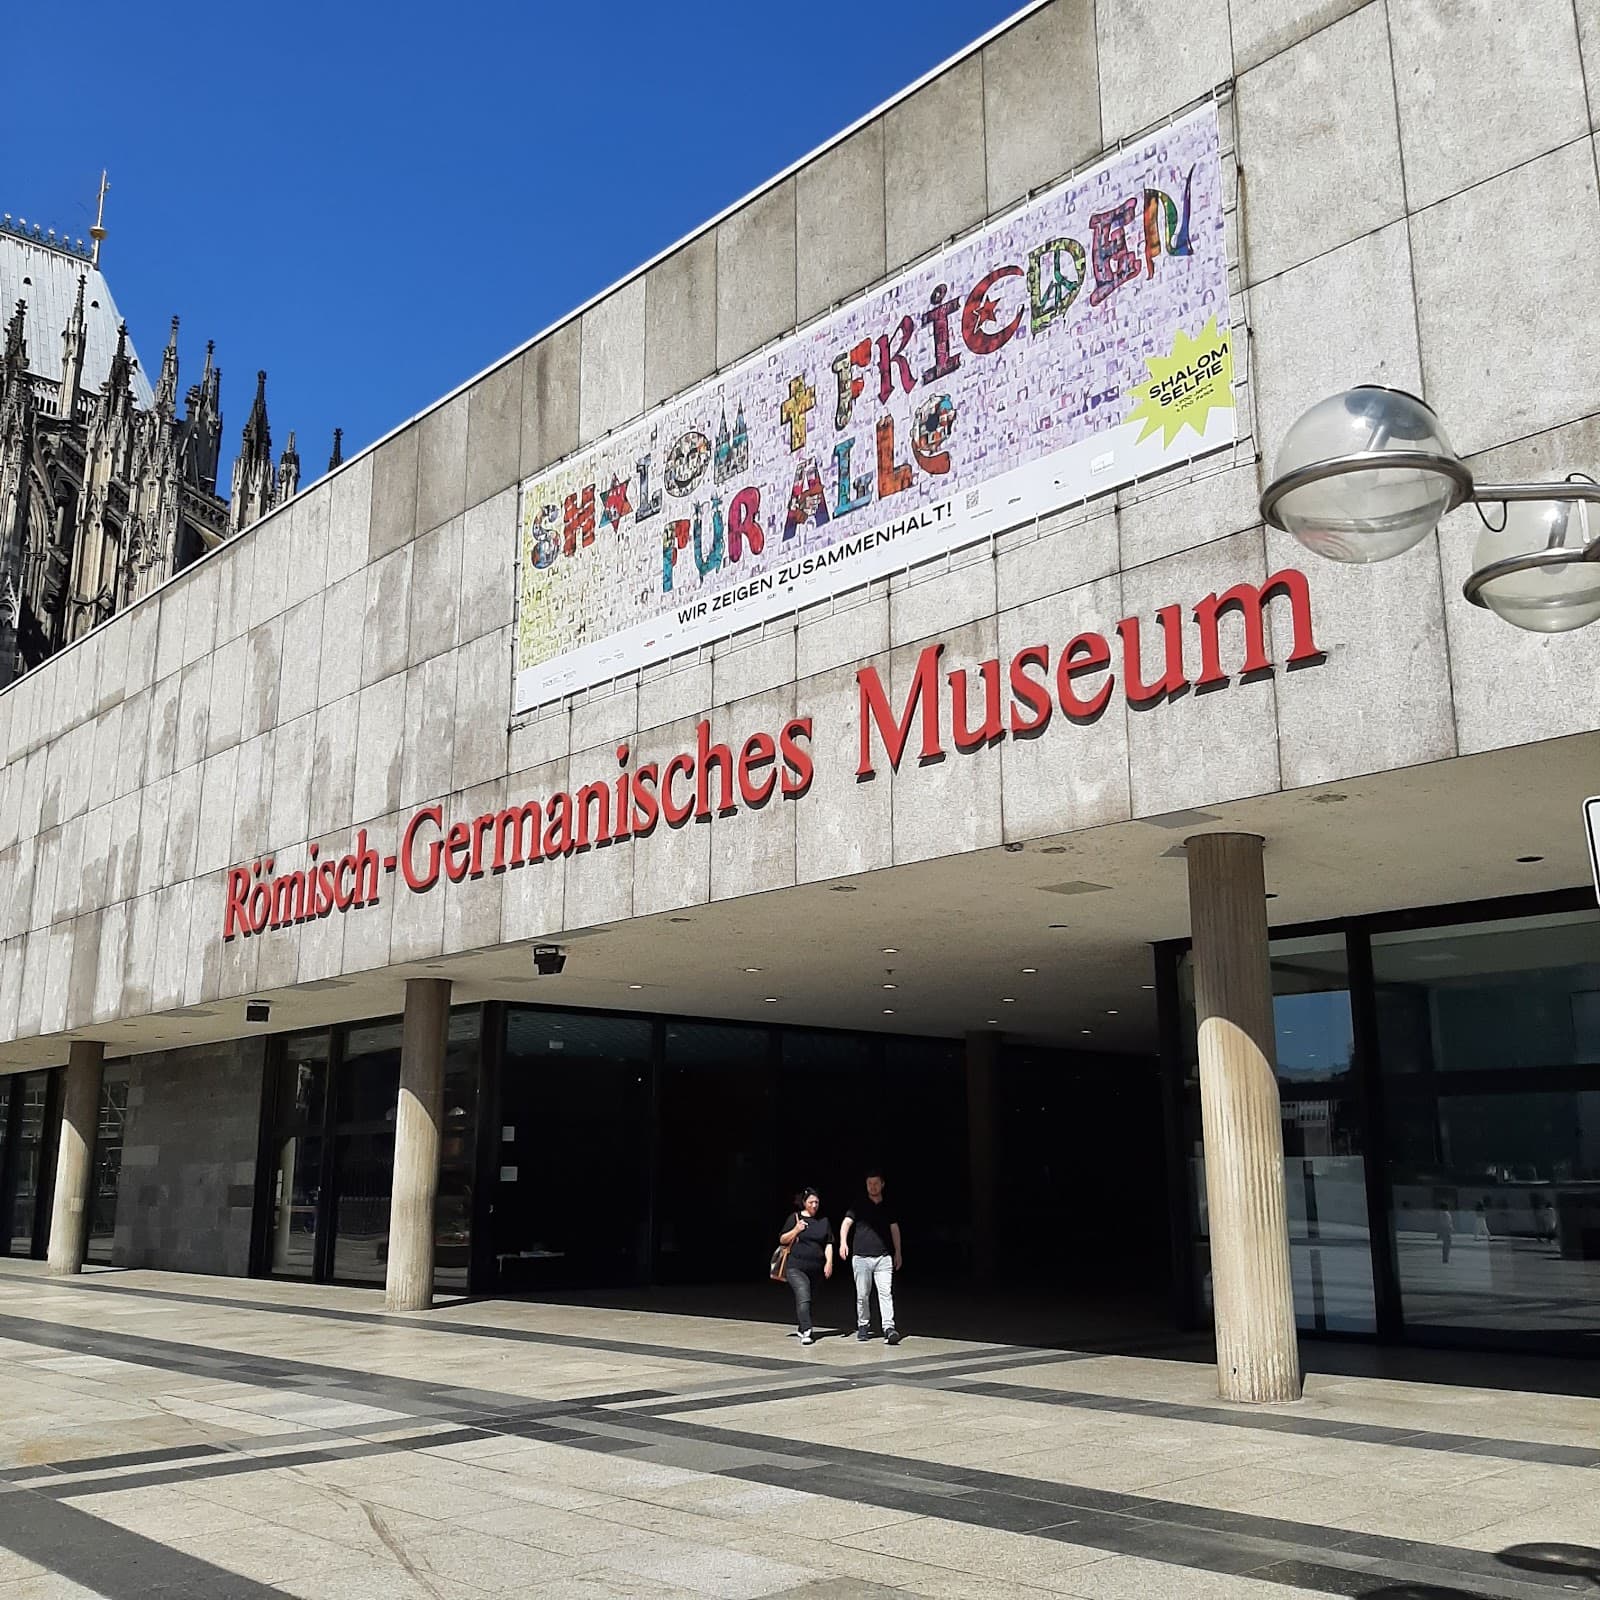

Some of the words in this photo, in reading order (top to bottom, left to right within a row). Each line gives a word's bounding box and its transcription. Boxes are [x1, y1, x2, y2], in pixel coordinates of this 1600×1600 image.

[1149, 343, 1229, 399] SHALOM
[1160, 360, 1224, 407] SELFIE
[662, 486, 765, 593] FÜR
[782, 392, 957, 542] ALLE
[678, 602, 708, 625] WIR
[712, 575, 773, 612] ZEIGEN
[778, 502, 953, 586] ZUSAMMENHALT!
[224, 717, 814, 941] Römisch-Germanisches
[855, 568, 1327, 784] Museum
